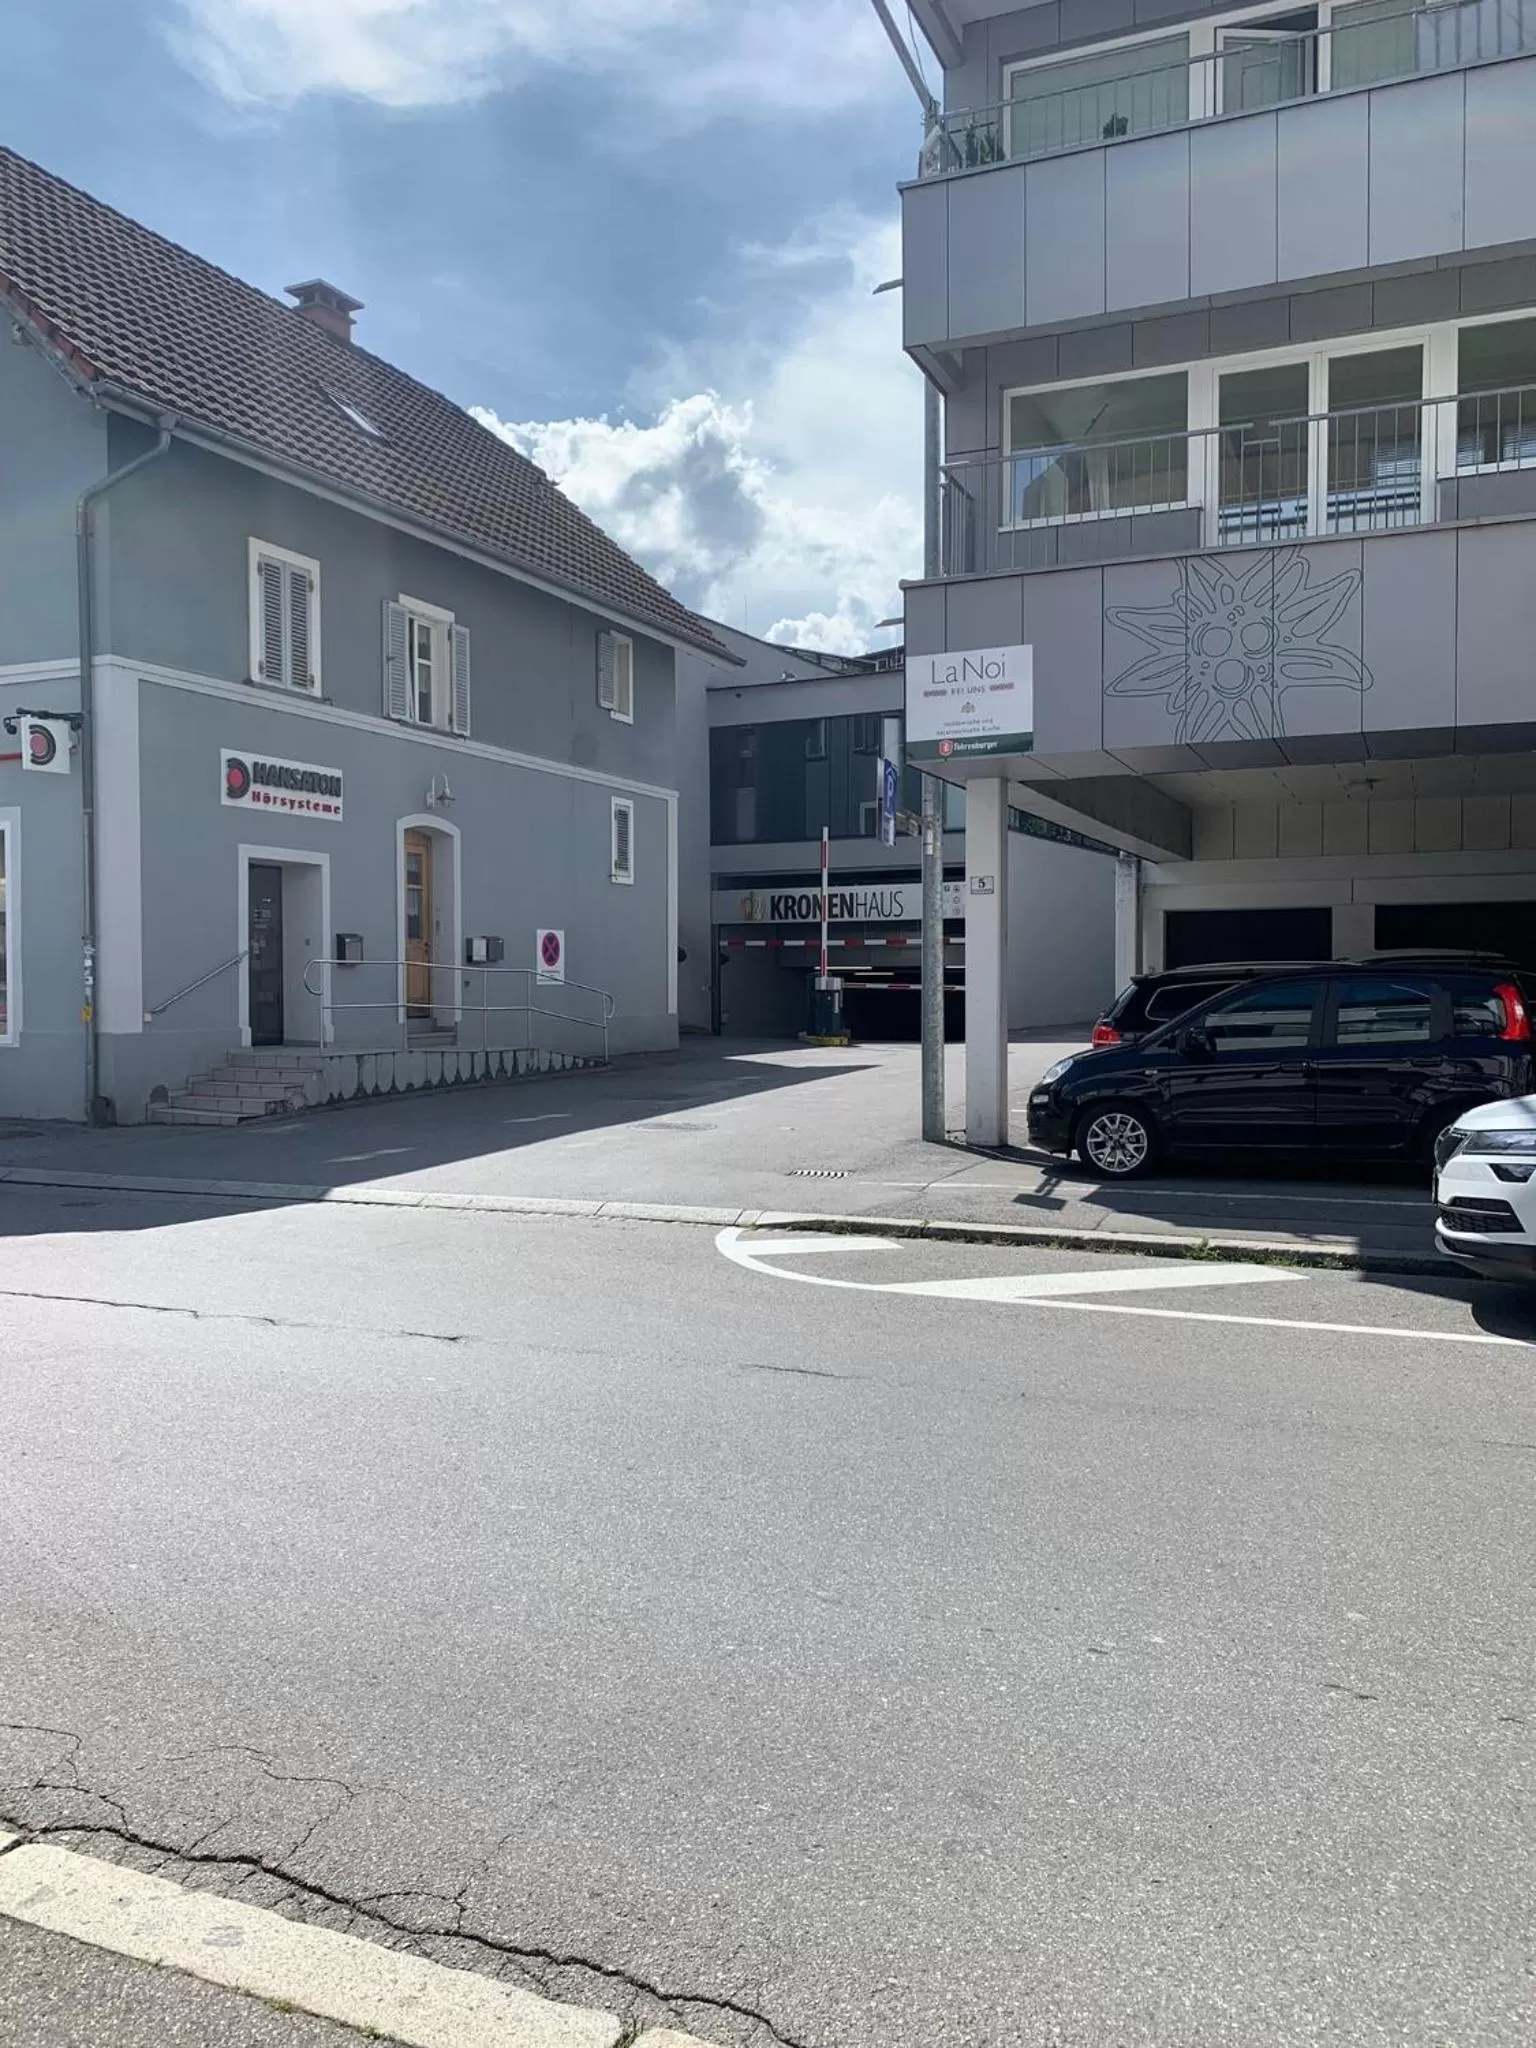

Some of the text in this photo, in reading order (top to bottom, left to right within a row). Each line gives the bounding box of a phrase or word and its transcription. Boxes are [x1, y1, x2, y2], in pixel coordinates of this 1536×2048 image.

[252, 761, 342, 798] HANSATON
[251, 790, 341, 815] Hörsysteme
[978, 878, 986, 889] 5
[770, 890, 904, 921] KRONENHAUS
